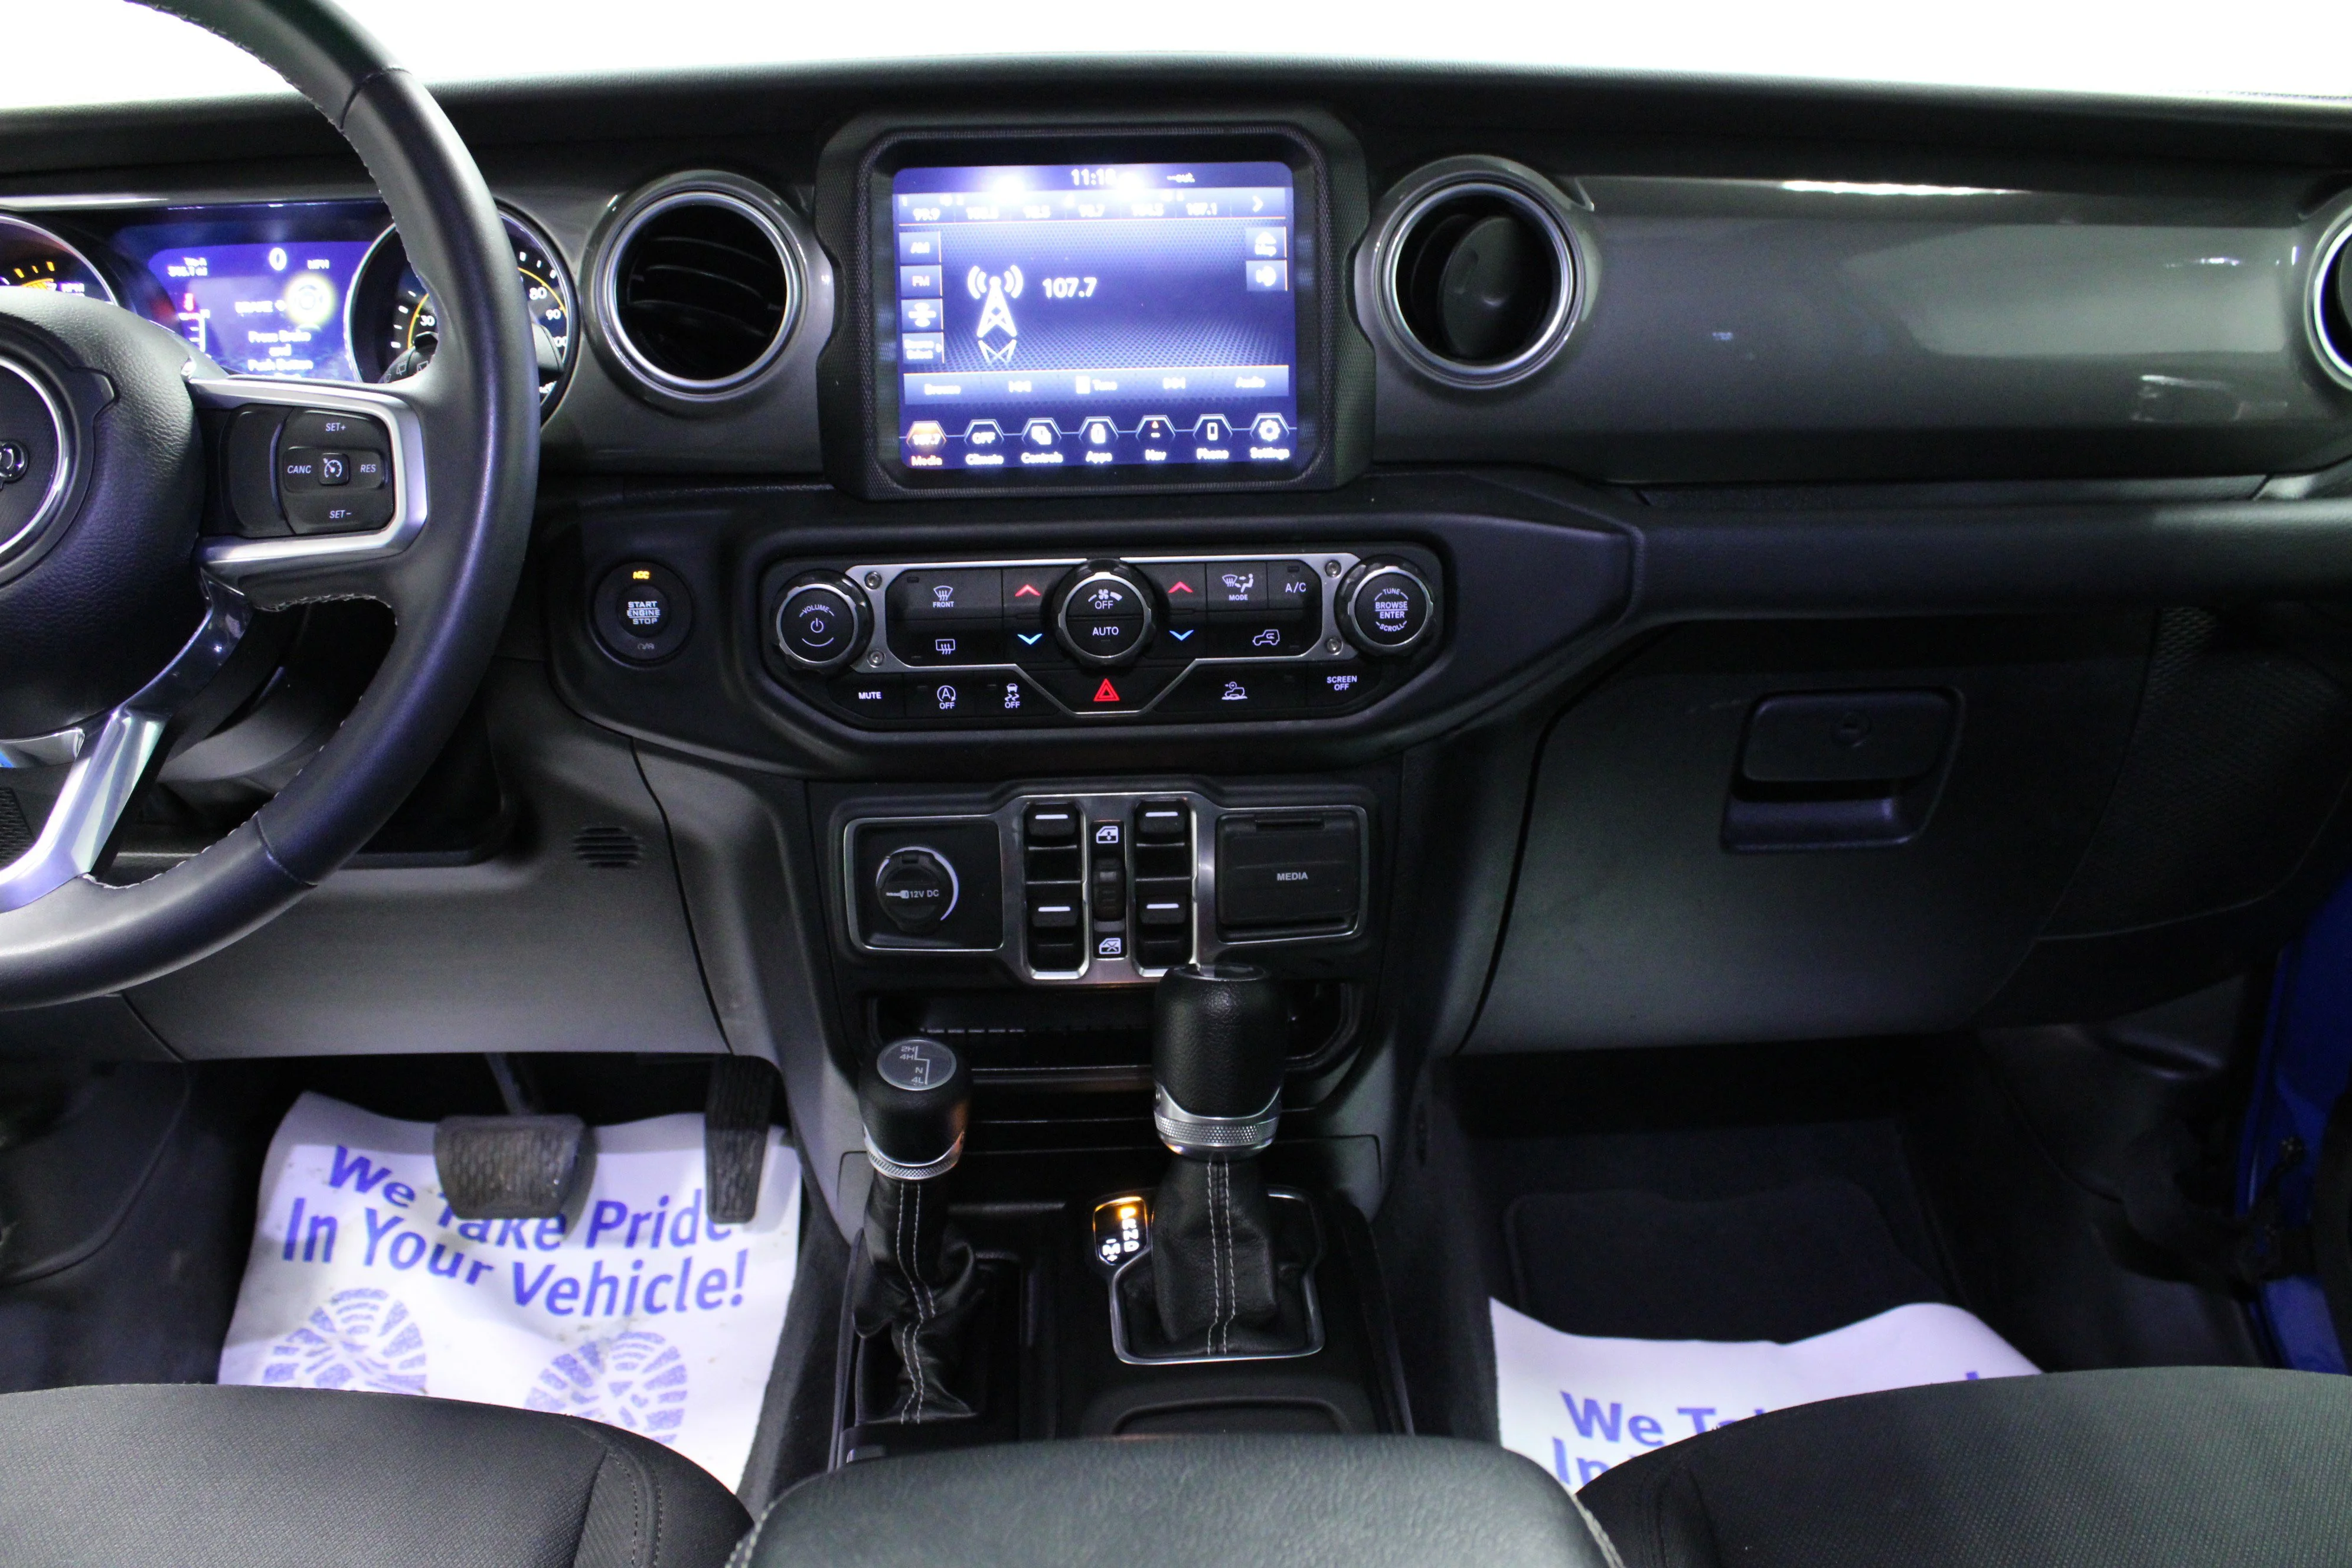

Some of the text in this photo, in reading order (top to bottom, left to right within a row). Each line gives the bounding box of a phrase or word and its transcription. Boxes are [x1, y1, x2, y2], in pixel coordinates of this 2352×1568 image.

[269, 247, 287, 271] 0
[912, 275, 930, 286] FM
[529, 286, 548, 300] 80
[1042, 277, 1097, 299] 107.7
[545, 309, 561, 320] 90
[419, 315, 436, 326] 30
[553, 336, 567, 347] 00
[972, 431, 996, 444] OFF
[1145, 449, 1167, 461] Nav
[1196, 447, 1229, 460] Phone
[911, 455, 943, 466] Media
[287, 465, 312, 474] CANC
[360, 463, 376, 473] RES
[633, 570, 650, 580] ACC
[1285, 582, 1306, 593] A/C
[1383, 587, 1401, 596] TUNE
[628, 600, 658, 609] START
[802, 604, 830, 615] VOLUME
[1095, 600, 1114, 610] OFF
[1375, 601, 1408, 609] BROWSE
[1380, 611, 1405, 619] ENTER
[1092, 626, 1119, 636] AUTO
[1379, 622, 1405, 632] SCROLL
[1327, 675, 1357, 684] SCREEN
[858, 691, 882, 700] MUTE
[1004, 701, 1020, 709] OFF
[1277, 871, 1309, 881] MEDIA
[329, 1145, 416, 1208] We
[1123, 1229, 1139, 1241] N
[1102, 1243, 1121, 1256] M
[1124, 1240, 1140, 1252] D
[282, 1197, 749, 1318] In Your Vehicle!
[1560, 1390, 1665, 1448] We
